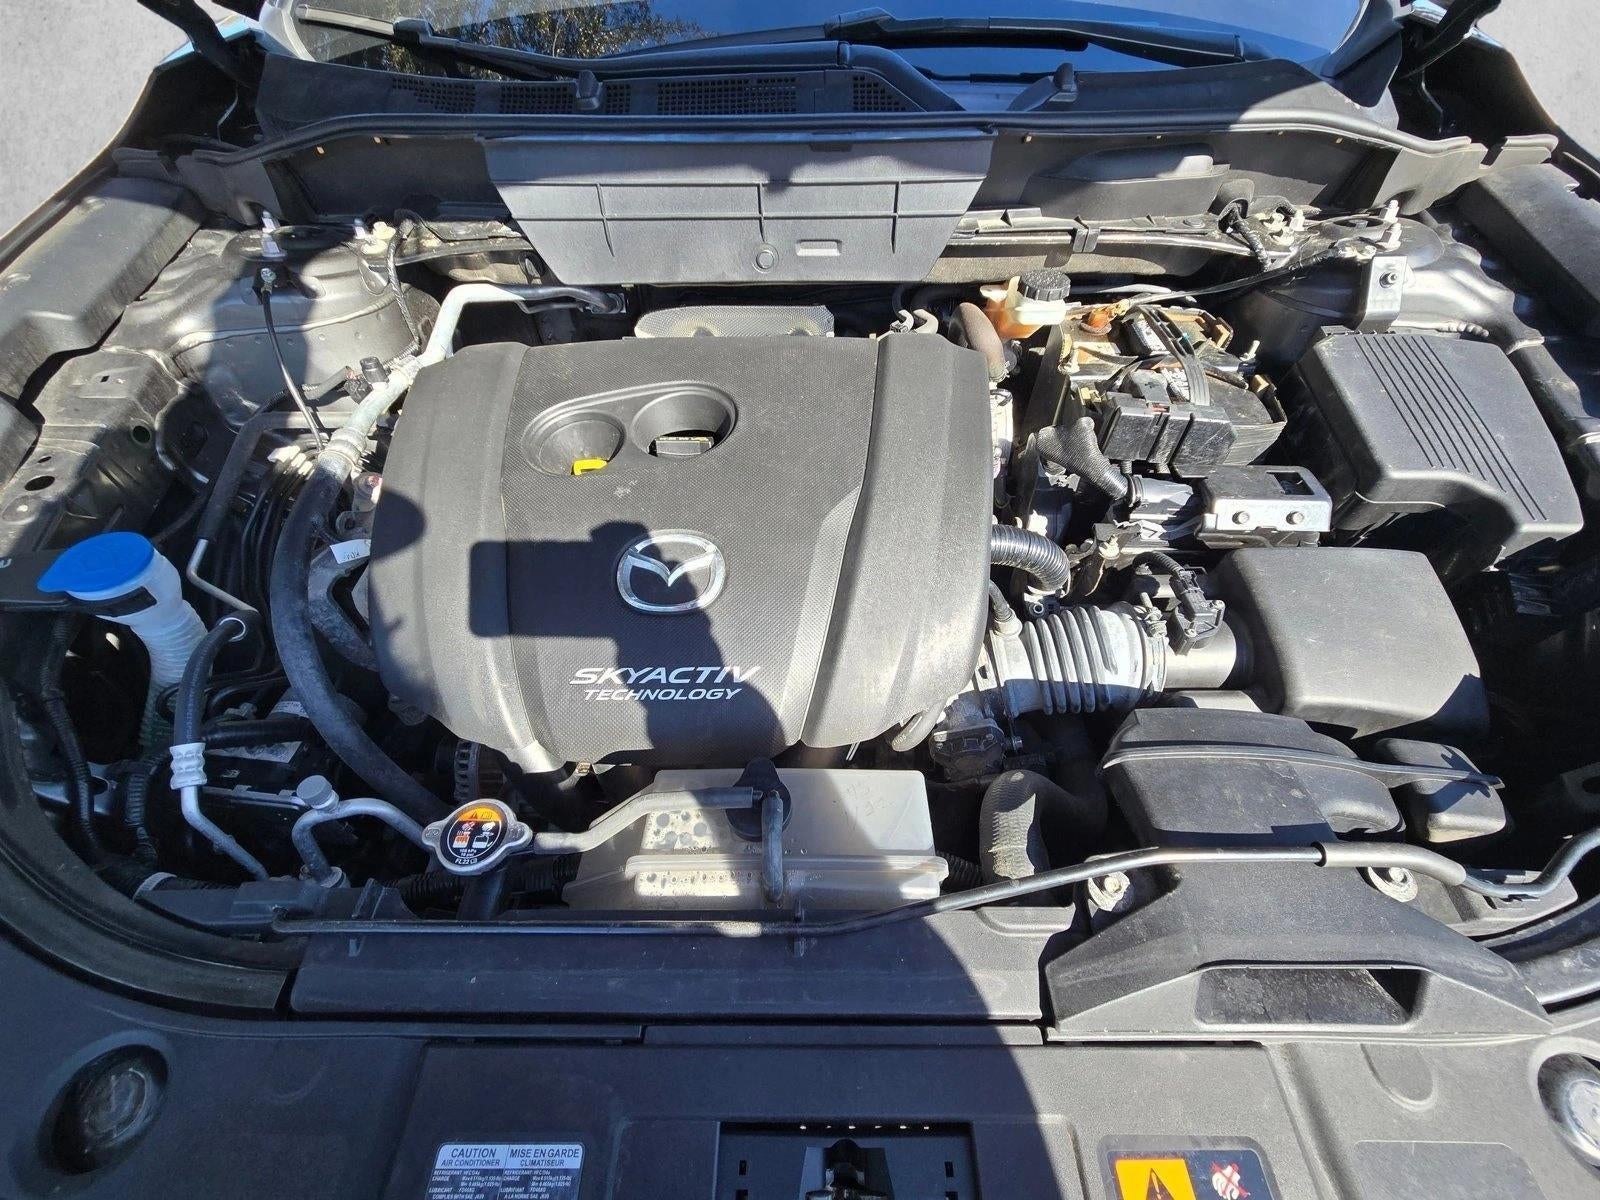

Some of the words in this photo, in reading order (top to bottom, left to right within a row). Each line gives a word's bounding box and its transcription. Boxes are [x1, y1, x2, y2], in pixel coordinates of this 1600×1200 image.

[569, 665, 761, 685] SKYACTIV
[584, 688, 742, 701] TECHNOLOGY
[451, 1148, 496, 1158] CAUTION
[509, 1148, 532, 1158] MISE
[533, 1148, 547, 1158] EN
[547, 1148, 580, 1158] GARDE
[520, 1159, 564, 1167] CLIMATISEUR
